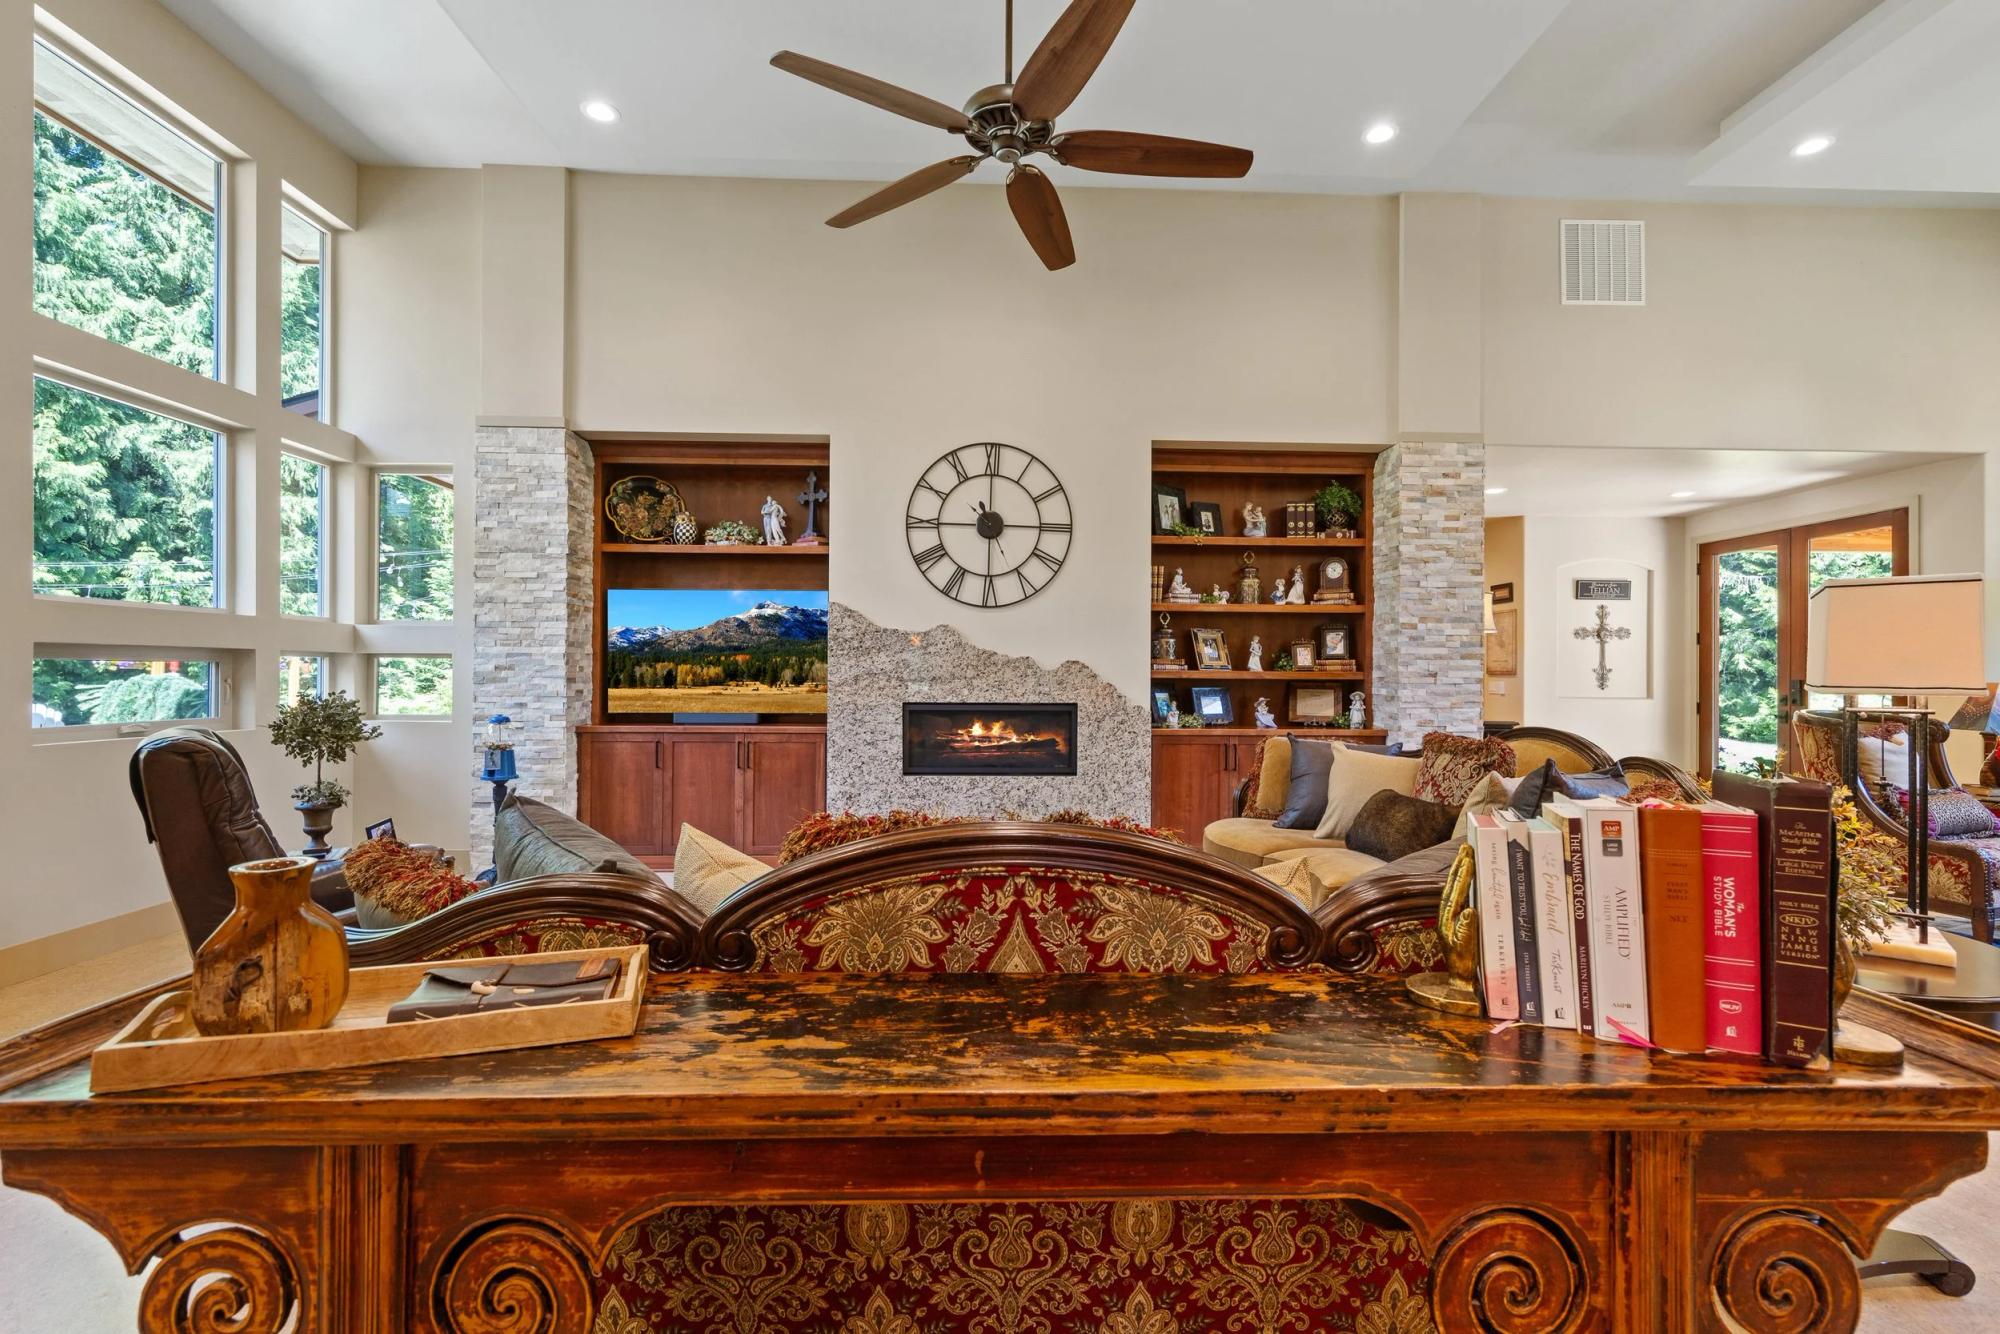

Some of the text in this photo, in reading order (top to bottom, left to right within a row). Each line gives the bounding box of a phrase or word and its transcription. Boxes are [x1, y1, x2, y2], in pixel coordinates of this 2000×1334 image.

[1516, 853, 1525, 871] WANT
[1518, 872, 1526, 881] TO
[1571, 832, 1586, 920] THE NAMES OF GOD
[1518, 882, 1528, 901] TRUST
[1713, 875, 1724, 937] STUDY BIBLE
[1723, 877, 1737, 938] WOMAN'S
[1615, 887, 1631, 957] AMPLIFIED
[1785, 915, 1814, 925] NKJV
[1781, 926, 1818, 936] NEW
[1781, 934, 1818, 945] KING
[1781, 942, 1818, 952] JAMES
[1579, 945, 1590, 1010] MARILYN HICKEY
